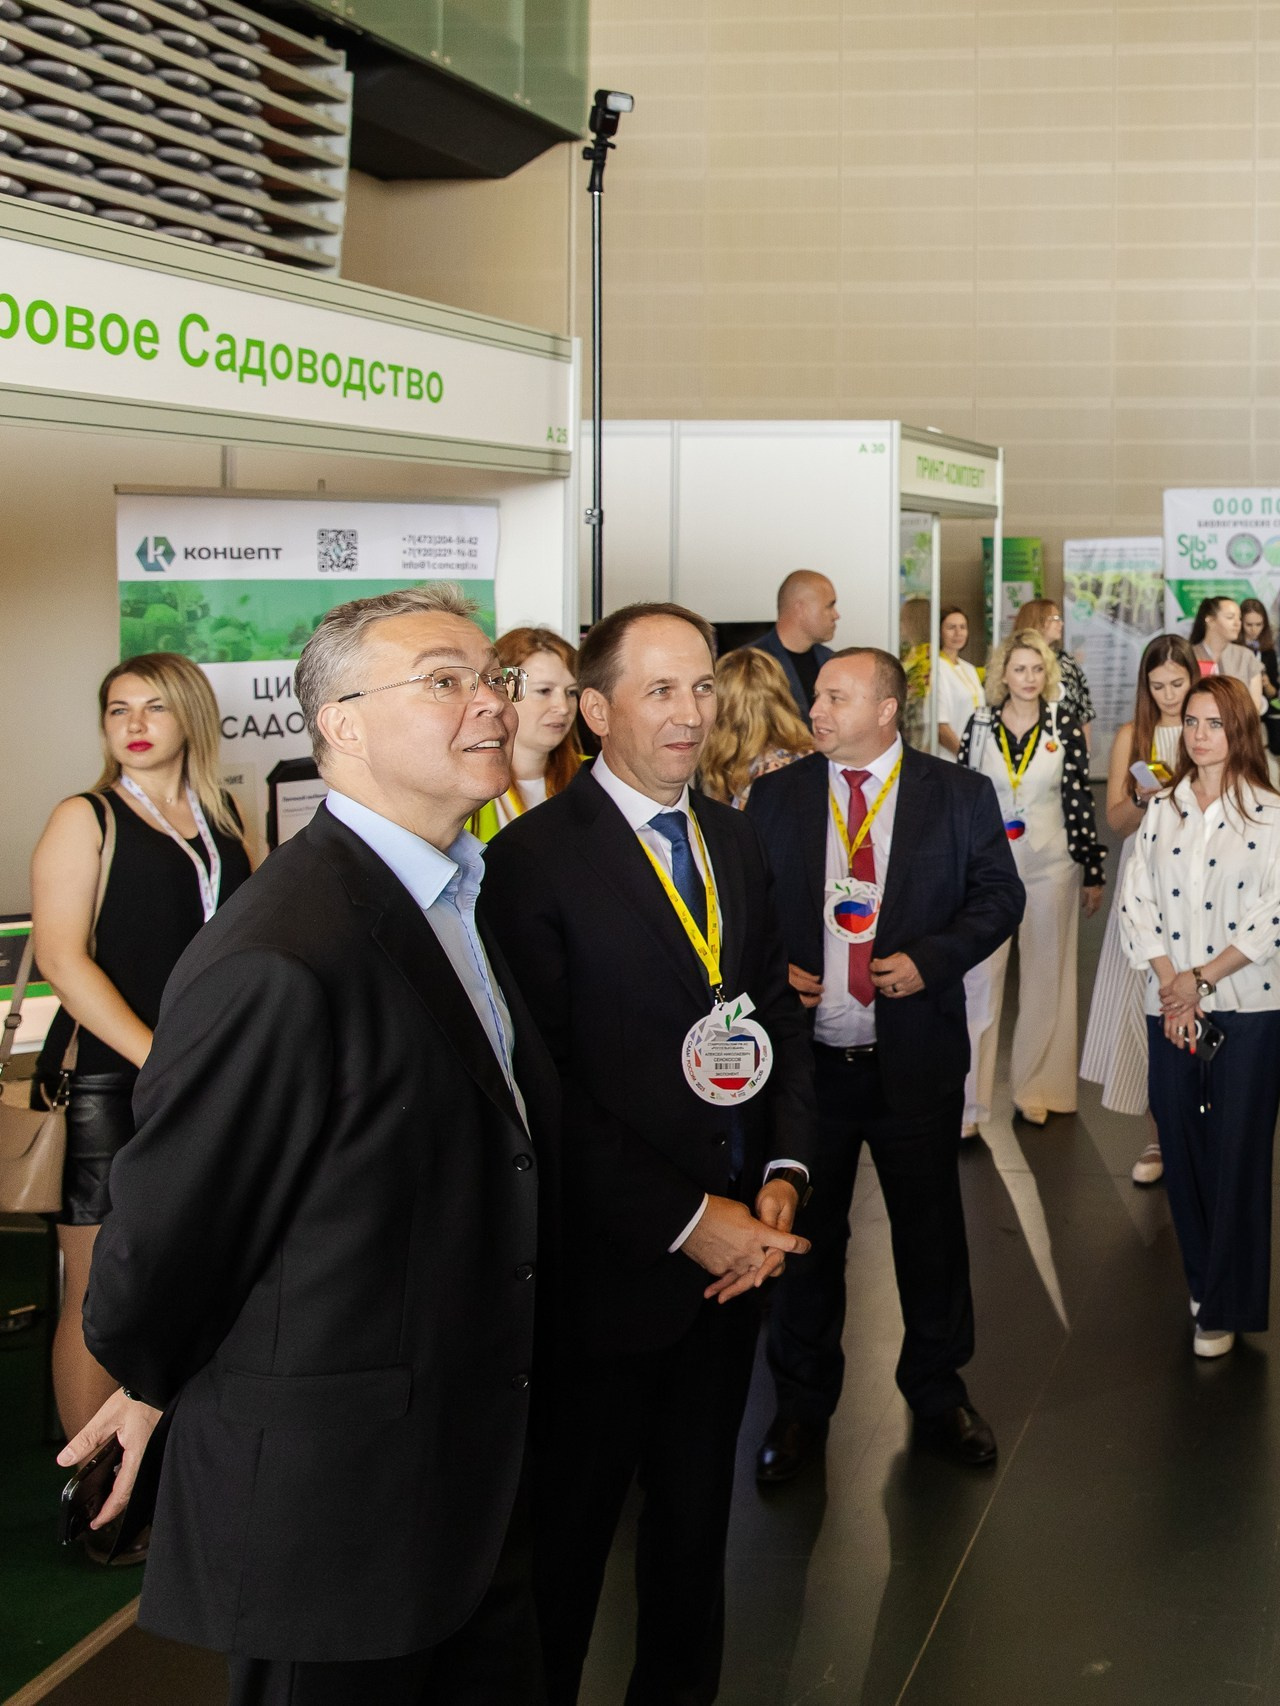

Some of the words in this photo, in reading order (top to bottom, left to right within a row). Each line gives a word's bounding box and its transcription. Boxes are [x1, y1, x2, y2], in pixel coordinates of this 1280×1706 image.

[178, 312, 444, 404] Садоводство
[1212, 497, 1254, 515] ООО
[184, 546, 283, 561] концепт
[253, 676, 292, 702] ЦИ
[220, 712, 306, 740] САДО
